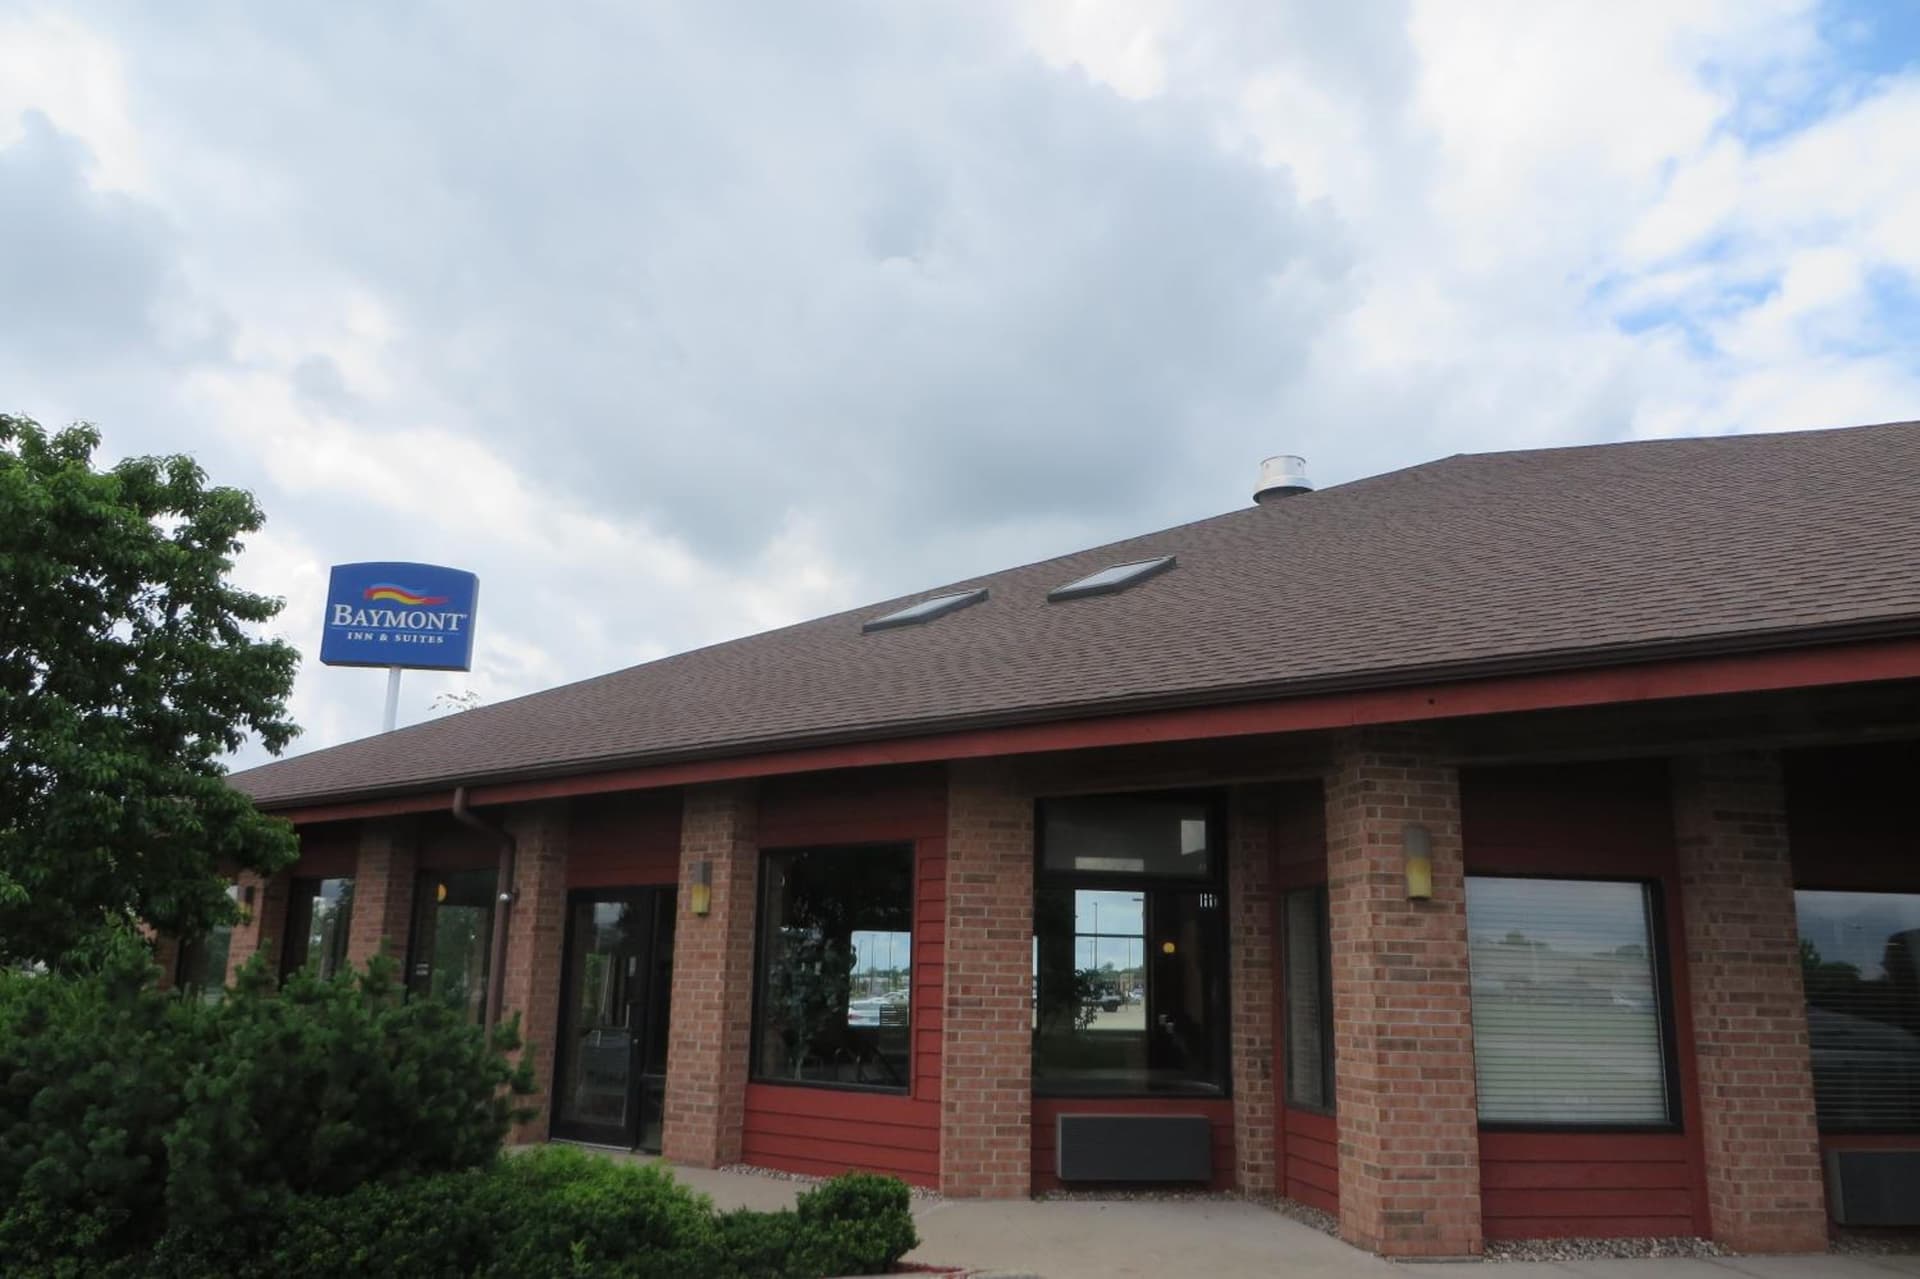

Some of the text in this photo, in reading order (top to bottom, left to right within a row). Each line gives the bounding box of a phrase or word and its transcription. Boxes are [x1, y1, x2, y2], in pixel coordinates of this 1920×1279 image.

[332, 604, 464, 631] BAYMONT
[347, 632, 444, 644] INN & SUITES
